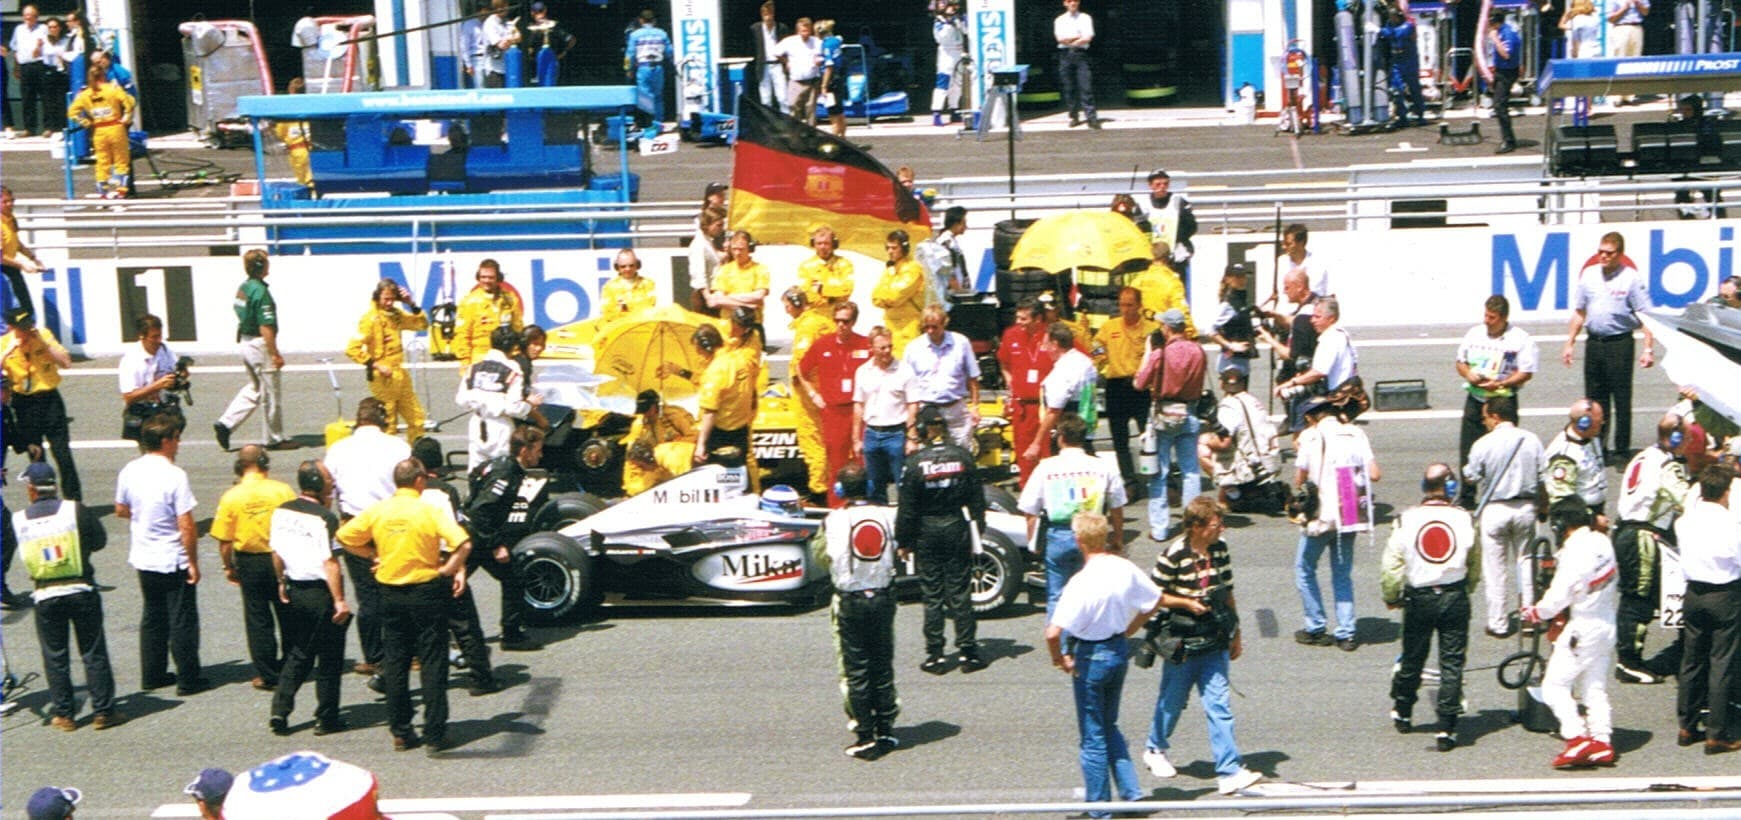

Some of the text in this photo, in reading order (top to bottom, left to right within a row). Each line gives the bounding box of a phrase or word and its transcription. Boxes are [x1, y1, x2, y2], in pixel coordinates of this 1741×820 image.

[1694, 59, 1741, 71] PROST
[919, 461, 961, 476] Team
[654, 489, 700, 504] Mbil
[720, 554, 799, 578] Mika
[1663, 609, 1687, 627] 22
